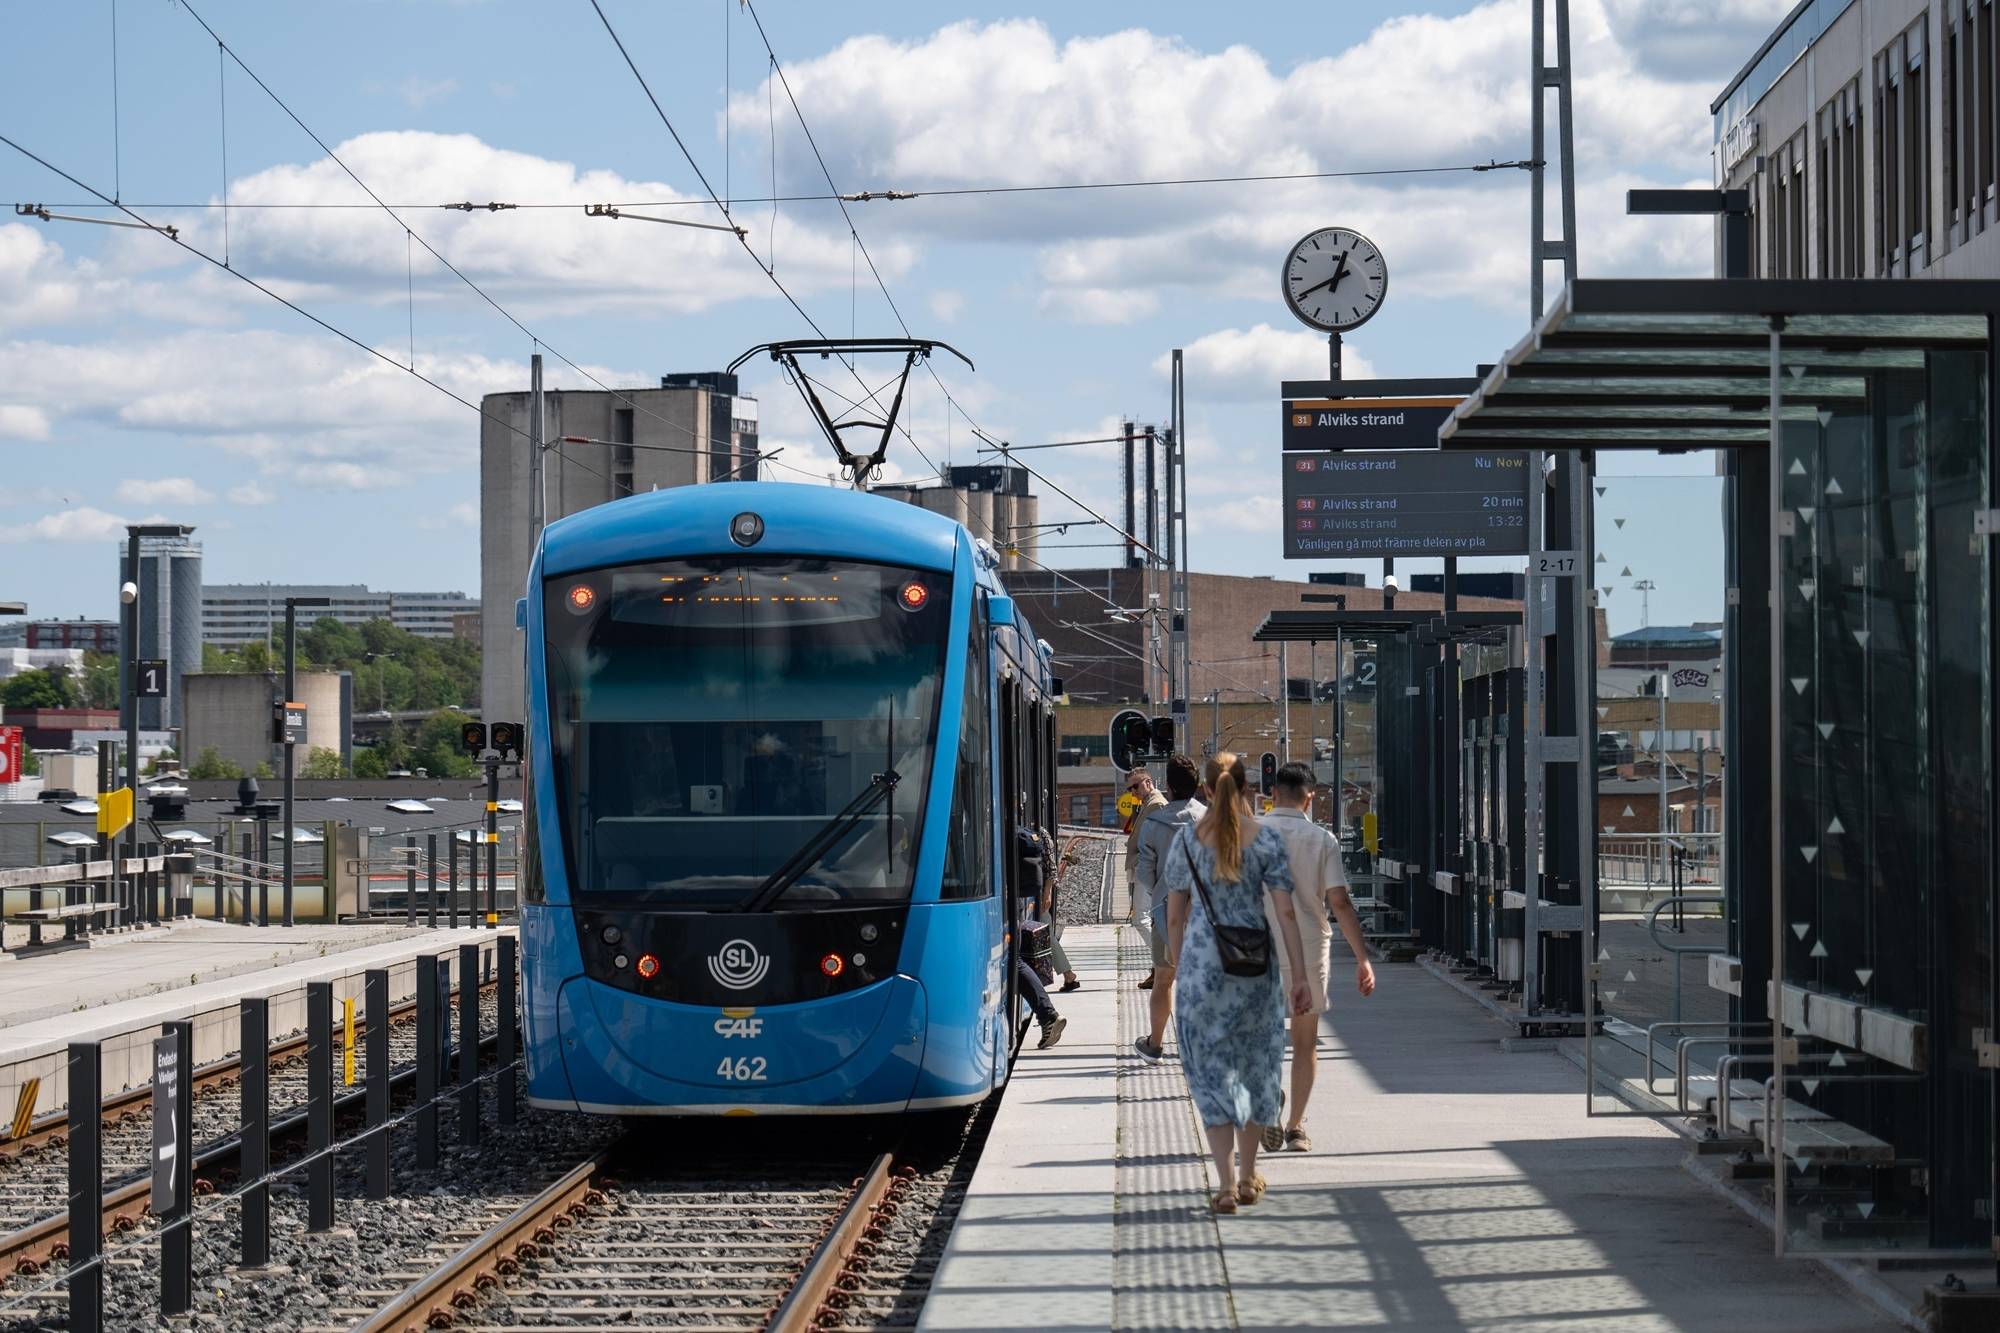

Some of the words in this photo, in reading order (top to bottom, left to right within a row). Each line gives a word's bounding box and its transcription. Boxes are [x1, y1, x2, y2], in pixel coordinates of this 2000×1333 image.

[1297, 416, 1307, 424] 31
[1318, 413, 1358, 426] Alviks
[1361, 412, 1404, 425] strand
[1300, 461, 1311, 470] 31
[1322, 460, 1357, 470] Alviks
[1359, 459, 1396, 470] strand
[1475, 457, 1491, 468] Nu
[1496, 457, 1522, 468] Now
[1302, 500, 1312, 509] 31
[1322, 499, 1358, 510] Alviks
[1360, 498, 1397, 509] strand
[1482, 496, 1498, 507] 20
[1501, 496, 1524, 507] min
[1302, 520, 1312, 529] 31
[1323, 519, 1358, 529] Alviks
[1360, 518, 1397, 529] strand
[1488, 515, 1523, 527] 13:22
[1297, 538, 1344, 551] Vänligen
[1346, 538, 1359, 551] gå
[1361, 537, 1382, 548] mot
[1385, 537, 1421, 548] främre
[1423, 536, 1452, 548] delen
[1455, 538, 1468, 547] av
[1470, 536, 1486, 549] pla
[1540, 559, 1574, 571] 2-17
[146, 670, 159, 692] 1
[1361, 662, 1377, 685] 2
[726, 949, 752, 968] SL
[714, 1018, 764, 1039] CAF
[716, 1056, 767, 1081] 462
